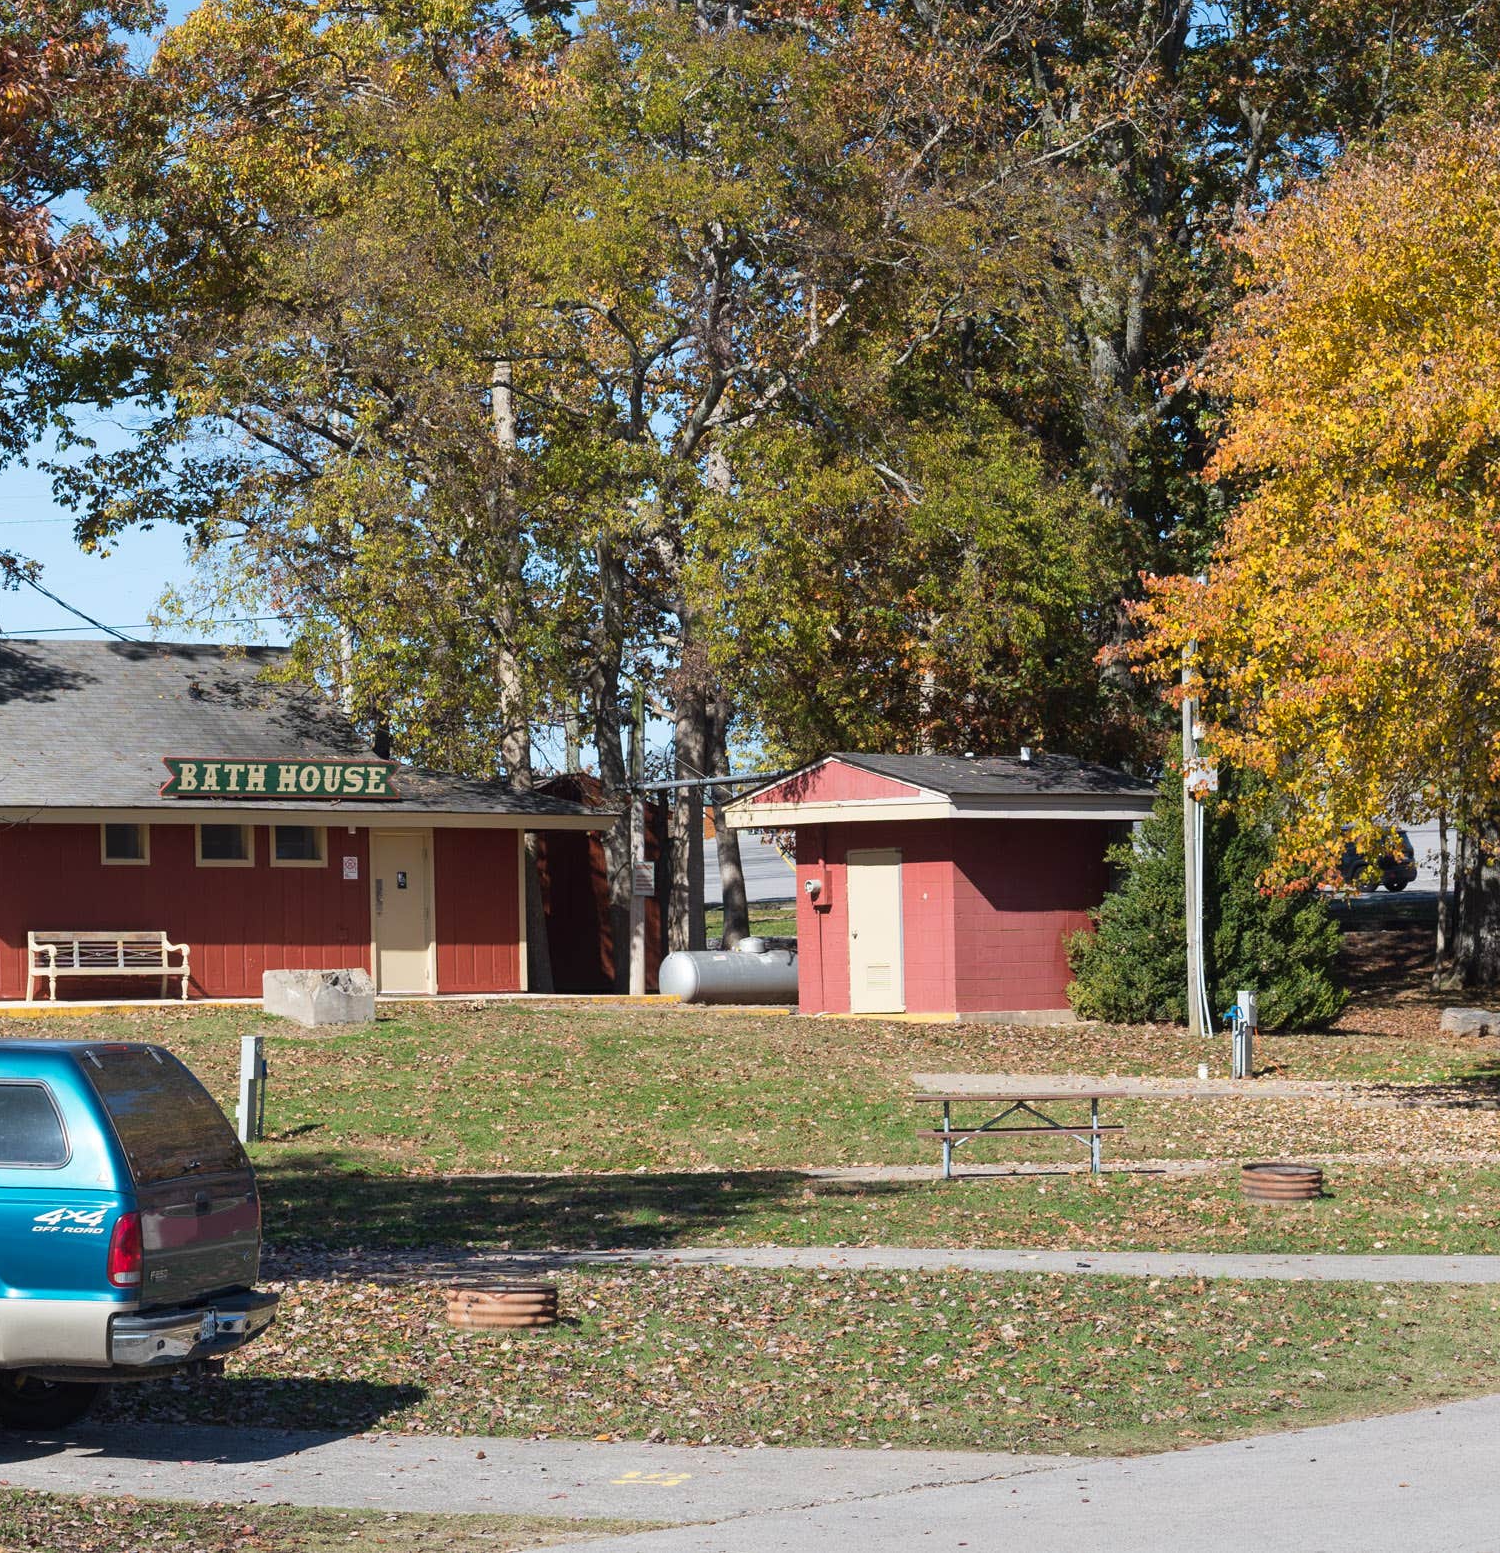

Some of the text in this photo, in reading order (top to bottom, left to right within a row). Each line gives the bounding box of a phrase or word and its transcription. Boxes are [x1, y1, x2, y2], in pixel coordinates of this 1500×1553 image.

[177, 763, 387, 793] BATH HOUSE
[61, 1226, 105, 1234] ROAD
